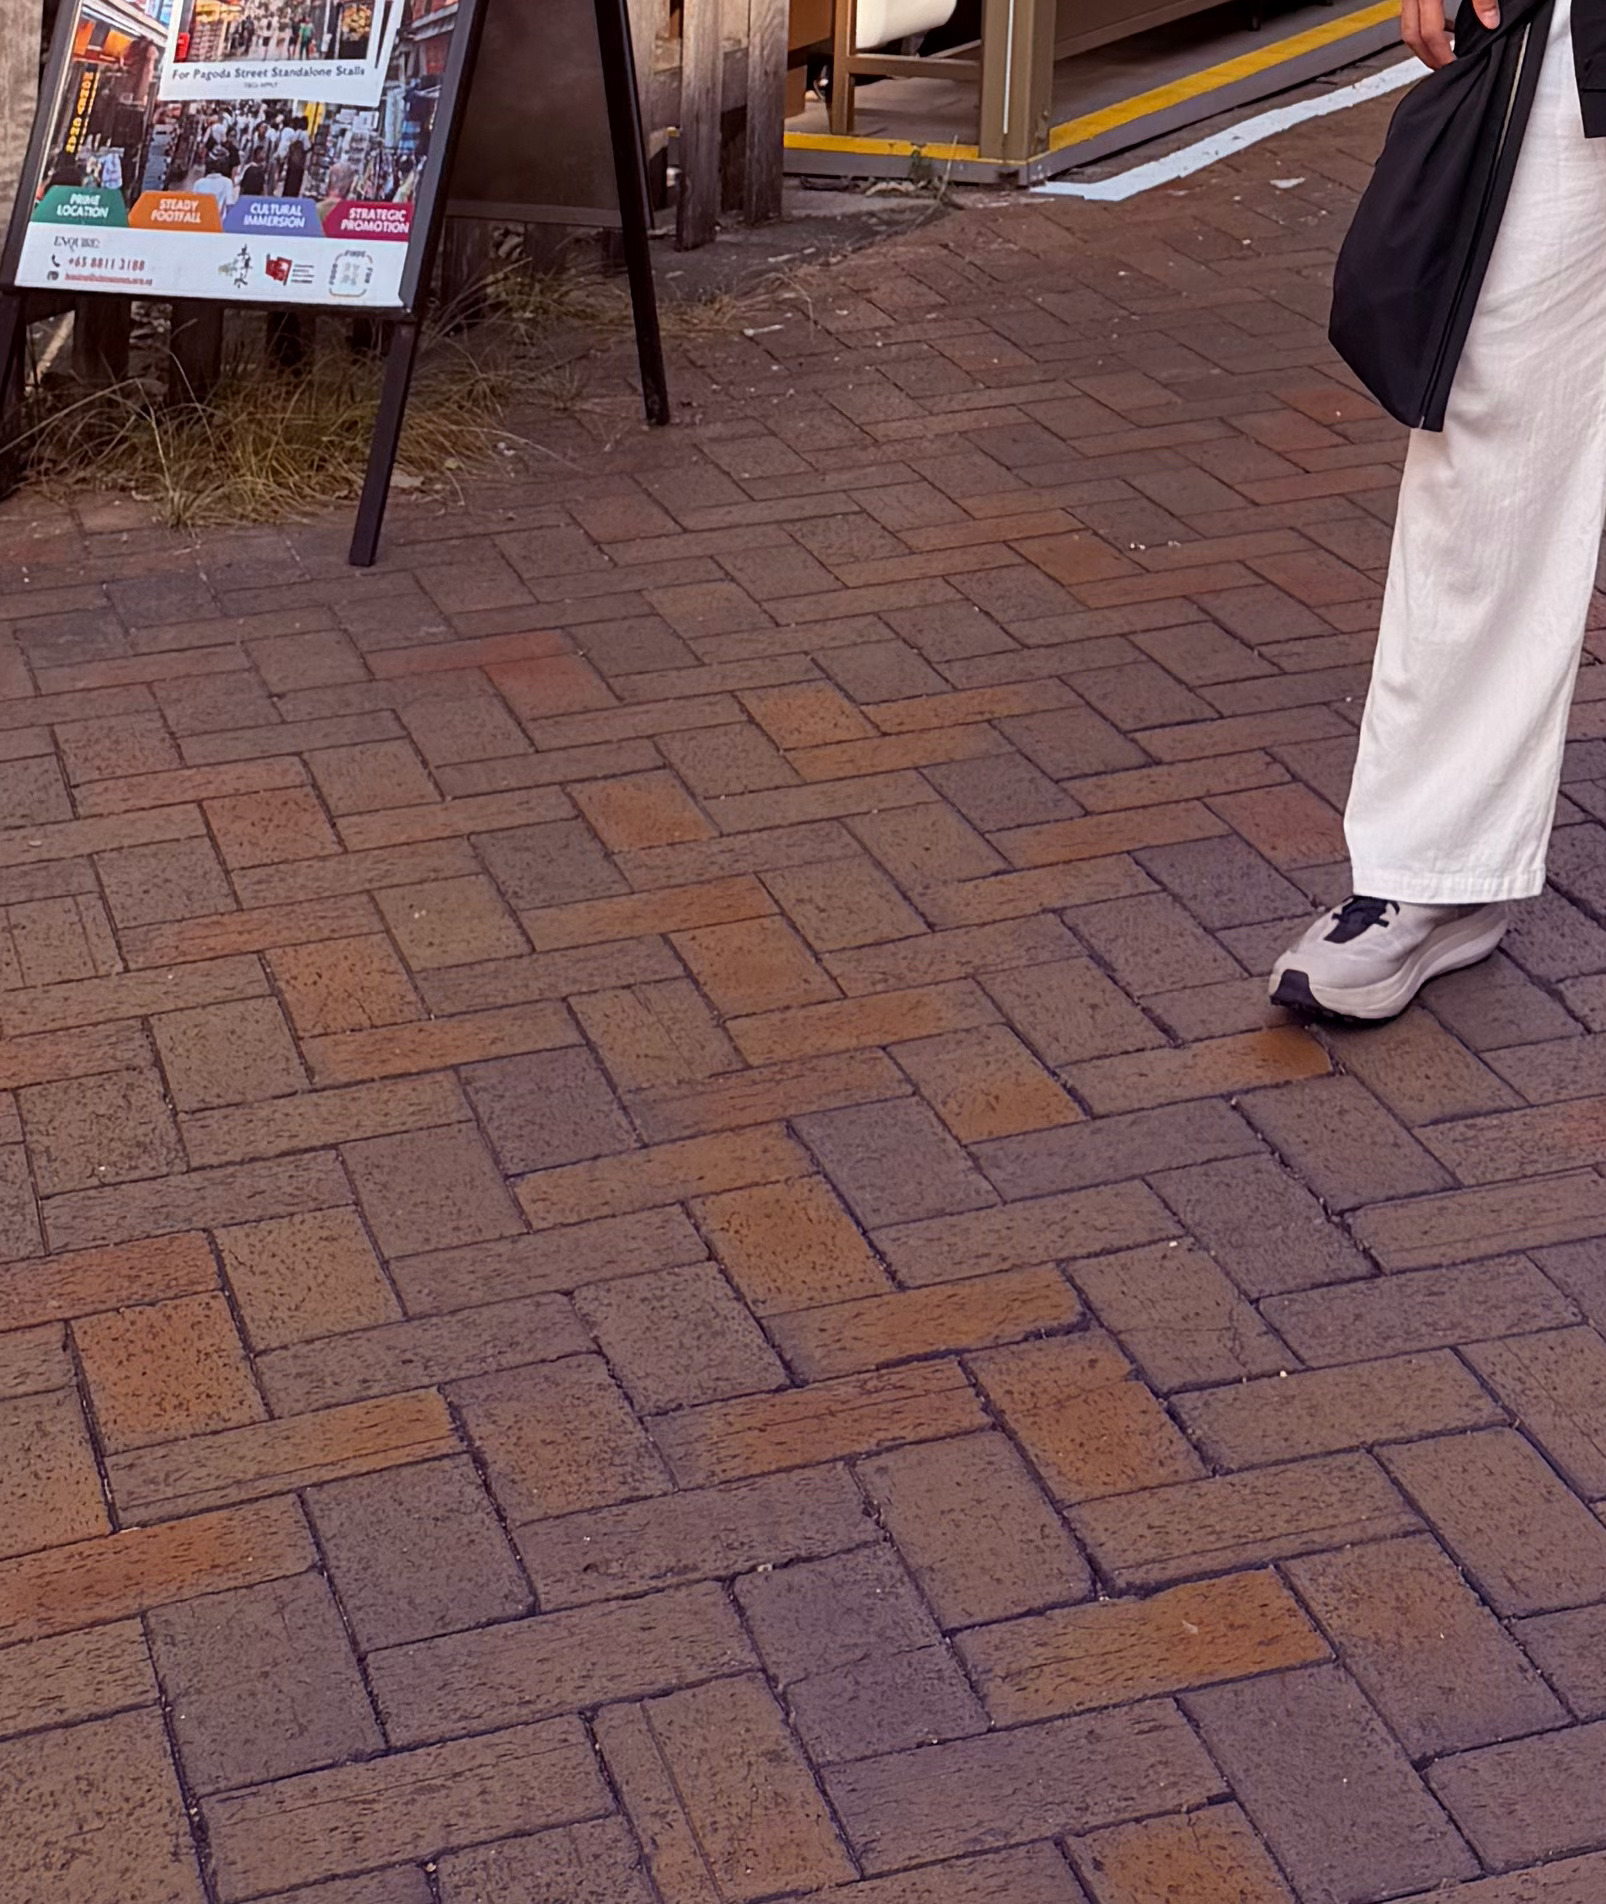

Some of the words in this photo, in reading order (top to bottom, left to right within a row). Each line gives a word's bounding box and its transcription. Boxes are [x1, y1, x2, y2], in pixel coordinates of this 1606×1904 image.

[172, 68, 190, 80] For
[193, 69, 231, 82] Pagoda
[234, 67, 268, 79] Street
[271, 66, 333, 78] Standalone
[336, 65, 366, 77] Stalls
[69, 193, 101, 206] PRIME
[158, 198, 199, 211] STEADY
[56, 204, 110, 219] LOCATION
[250, 202, 303, 216] CULTURAL
[348, 207, 407, 221] STRATEGIC
[150, 210, 201, 224] FOOTFALL
[243, 215, 306, 229] IMMERSION
[340, 220, 410, 234] PROMOTION
[68, 256, 87, 268] +65
